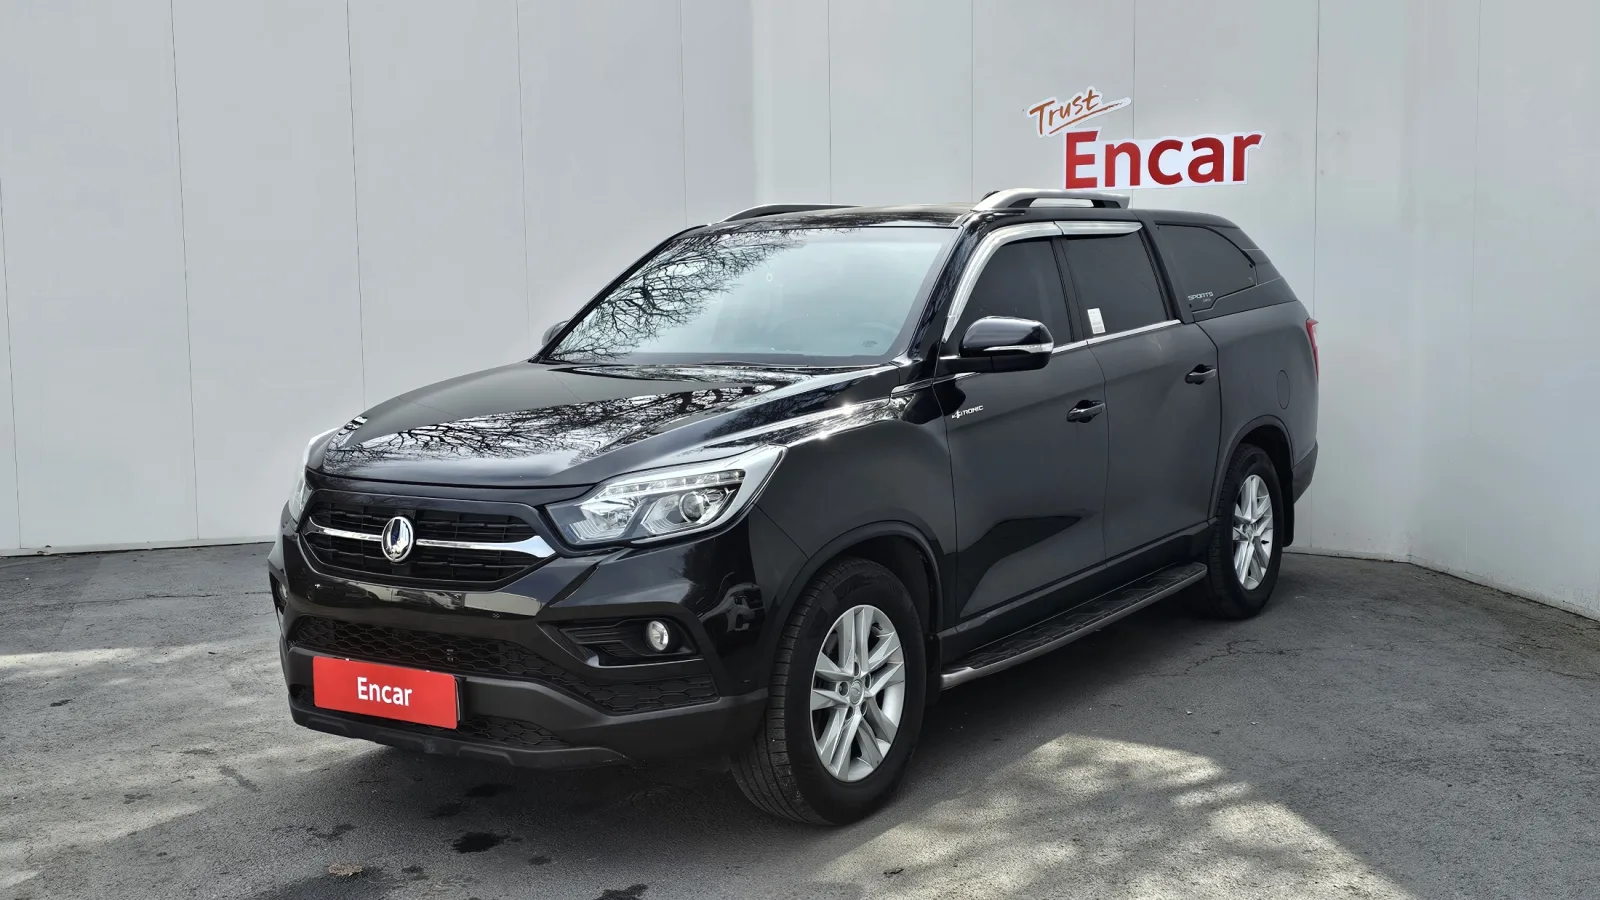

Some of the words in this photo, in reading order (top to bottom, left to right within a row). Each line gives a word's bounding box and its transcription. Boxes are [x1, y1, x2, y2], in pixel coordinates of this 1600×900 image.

[1029, 89, 1100, 135] Trust
[1065, 130, 1263, 189] Encar
[1187, 291, 1214, 301] SPORTS
[357, 677, 412, 706] Encar
